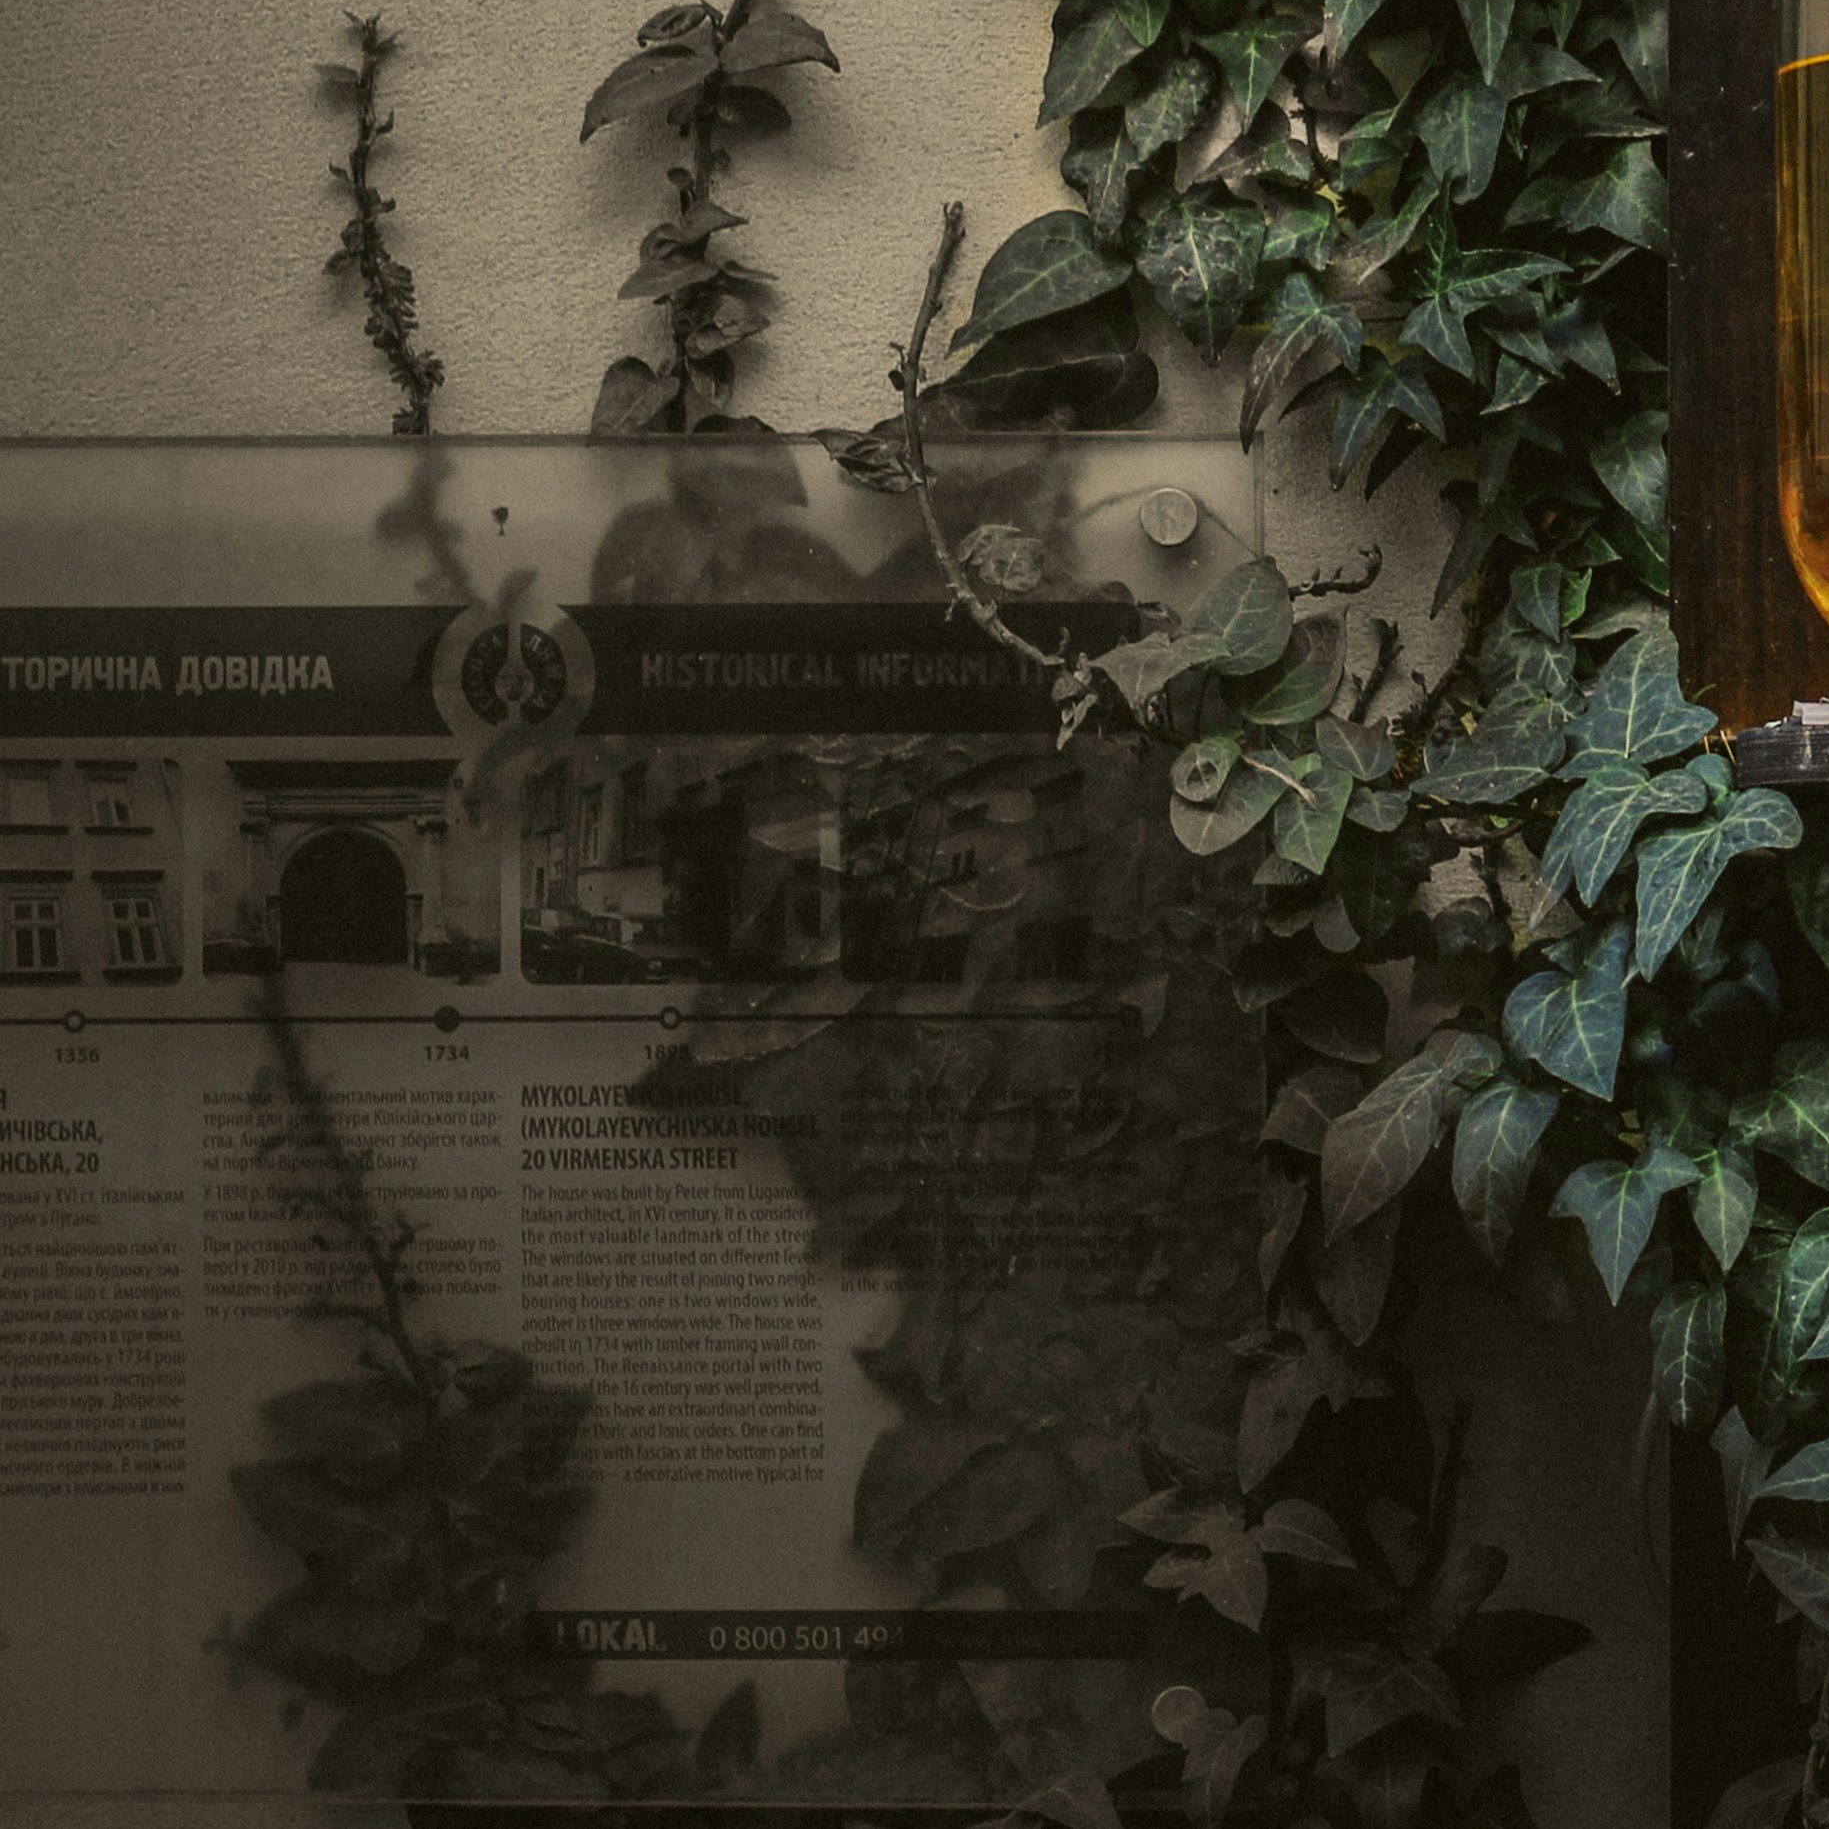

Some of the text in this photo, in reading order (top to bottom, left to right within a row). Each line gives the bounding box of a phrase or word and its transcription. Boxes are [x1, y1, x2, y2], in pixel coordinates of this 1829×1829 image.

[174, 655, 333, 697] ДОВІДКА
[641, 654, 844, 688] HISTORICAL
[54, 1048, 100, 1063] 1356
[424, 1045, 470, 1062] 1734
[520, 1115, 739, 1140] (MYKOLAYEVYCHIVSKA
[75, 1152, 100, 1173] 20
[520, 1147, 739, 1170] 20 VIRMENSKA STREET
[521, 1184, 546, 1201] The
[548, 1184, 590, 1201] house
[592, 1189, 619, 1201] was
[621, 1184, 653, 1201] built
[655, 1184, 673, 1205] by
[675, 1184, 711, 1201] Peter
[713, 1184, 745, 1201] from
[521, 1205, 562, 1222] Italian
[627, 1206, 641, 1222] in
[643, 1205, 666, 1222] XVI
[722, 1205, 733, 1222] It
[735, 1206, 747, 1222] is
[521, 1227, 546, 1243] the
[548, 1228, 586, 1243] most
[588, 1227, 651, 1243] valuable
[653, 1227, 724, 1243] landmark
[726, 1227, 743, 1243] of
[746, 1227, 771, 1243] the
[521, 1249, 548, 1265] The
[550, 1249, 611, 1265] windows
[613, 1253, 637, 1265] are
[639, 1249, 696, 1265] situated
[698, 1253, 717, 1265] on
[719, 1249, 780, 1265] different
[521, 1271, 550, 1287] that
[552, 1275, 574, 1287] are
[576, 1271, 613, 1291] likely
[615, 1271, 639, 1287] the
[641, 1271, 679, 1287] result
[681, 1271, 696, 1287] of
[698, 1271, 746, 1291] joining
[748, 1272, 775, 1287] two
[778, 1271, 822, 1291] neigh-
[521, 1291, 578, 1313] bouring
[638, 1296, 667, 1308] one
[669, 1292, 682, 1308] is
[684, 1293, 713, 1308] two
[715, 1291, 779, 1308] windows
[521, 1313, 574, 1329] another
[576, 1313, 587, 1329] is
[589, 1313, 625, 1329] three
[627, 1313, 686, 1329] windows
[728, 1313, 751, 1329] The
[753, 1313, 794, 1329] house
[796, 1317, 822, 1329] was
[521, 1335, 822, 1357] rebuilt in 1734 with timber framing wall con-
[593, 1357, 620, 1373] The
[622, 1357, 710, 1373] Renaissance
[712, 1357, 757, 1378] portal
[759, 1357, 793, 1373] with
[795, 1359, 822, 1373] two
[596, 1379, 619, 1395] the
[621, 1379, 639, 1395] 16
[641, 1380, 691, 1399] century
[693, 1383, 721, 1395] was
[723, 1379, 751, 1395] well
[753, 1379, 822, 1399] preserved,
[612, 1400, 646, 1417] have
[648, 1405, 665, 1417] an
[758, 1400, 822, 1417] combina-
[592, 1421, 626, 1438] Doric
[628, 1421, 656, 1438] and
[658, 1421, 690, 1438] Ionic
[740, 1421, 768, 1438] One
[770, 1426, 795, 1438] can
[797, 1421, 824, 1438] find
[601, 1443, 634, 1460] with
[636, 1443, 681, 1460] fascias
[683, 1445, 698, 1460] at
[700, 1443, 724, 1460] the
[726, 1443, 776, 1460] bottom
[778, 1445, 807, 1465] part
[809, 1443, 824, 1460] of
[621, 1469, 630, 1481] a
[632, 1465, 703, 1481] decorative
[705, 1466, 753, 1481] motive
[755, 1465, 802, 1485] typical
[804, 1465, 824, 1481] for
[710, 1626, 726, 1650] 0
[734, 1626, 786, 1650] 800
[794, 1626, 842, 1650] 501
